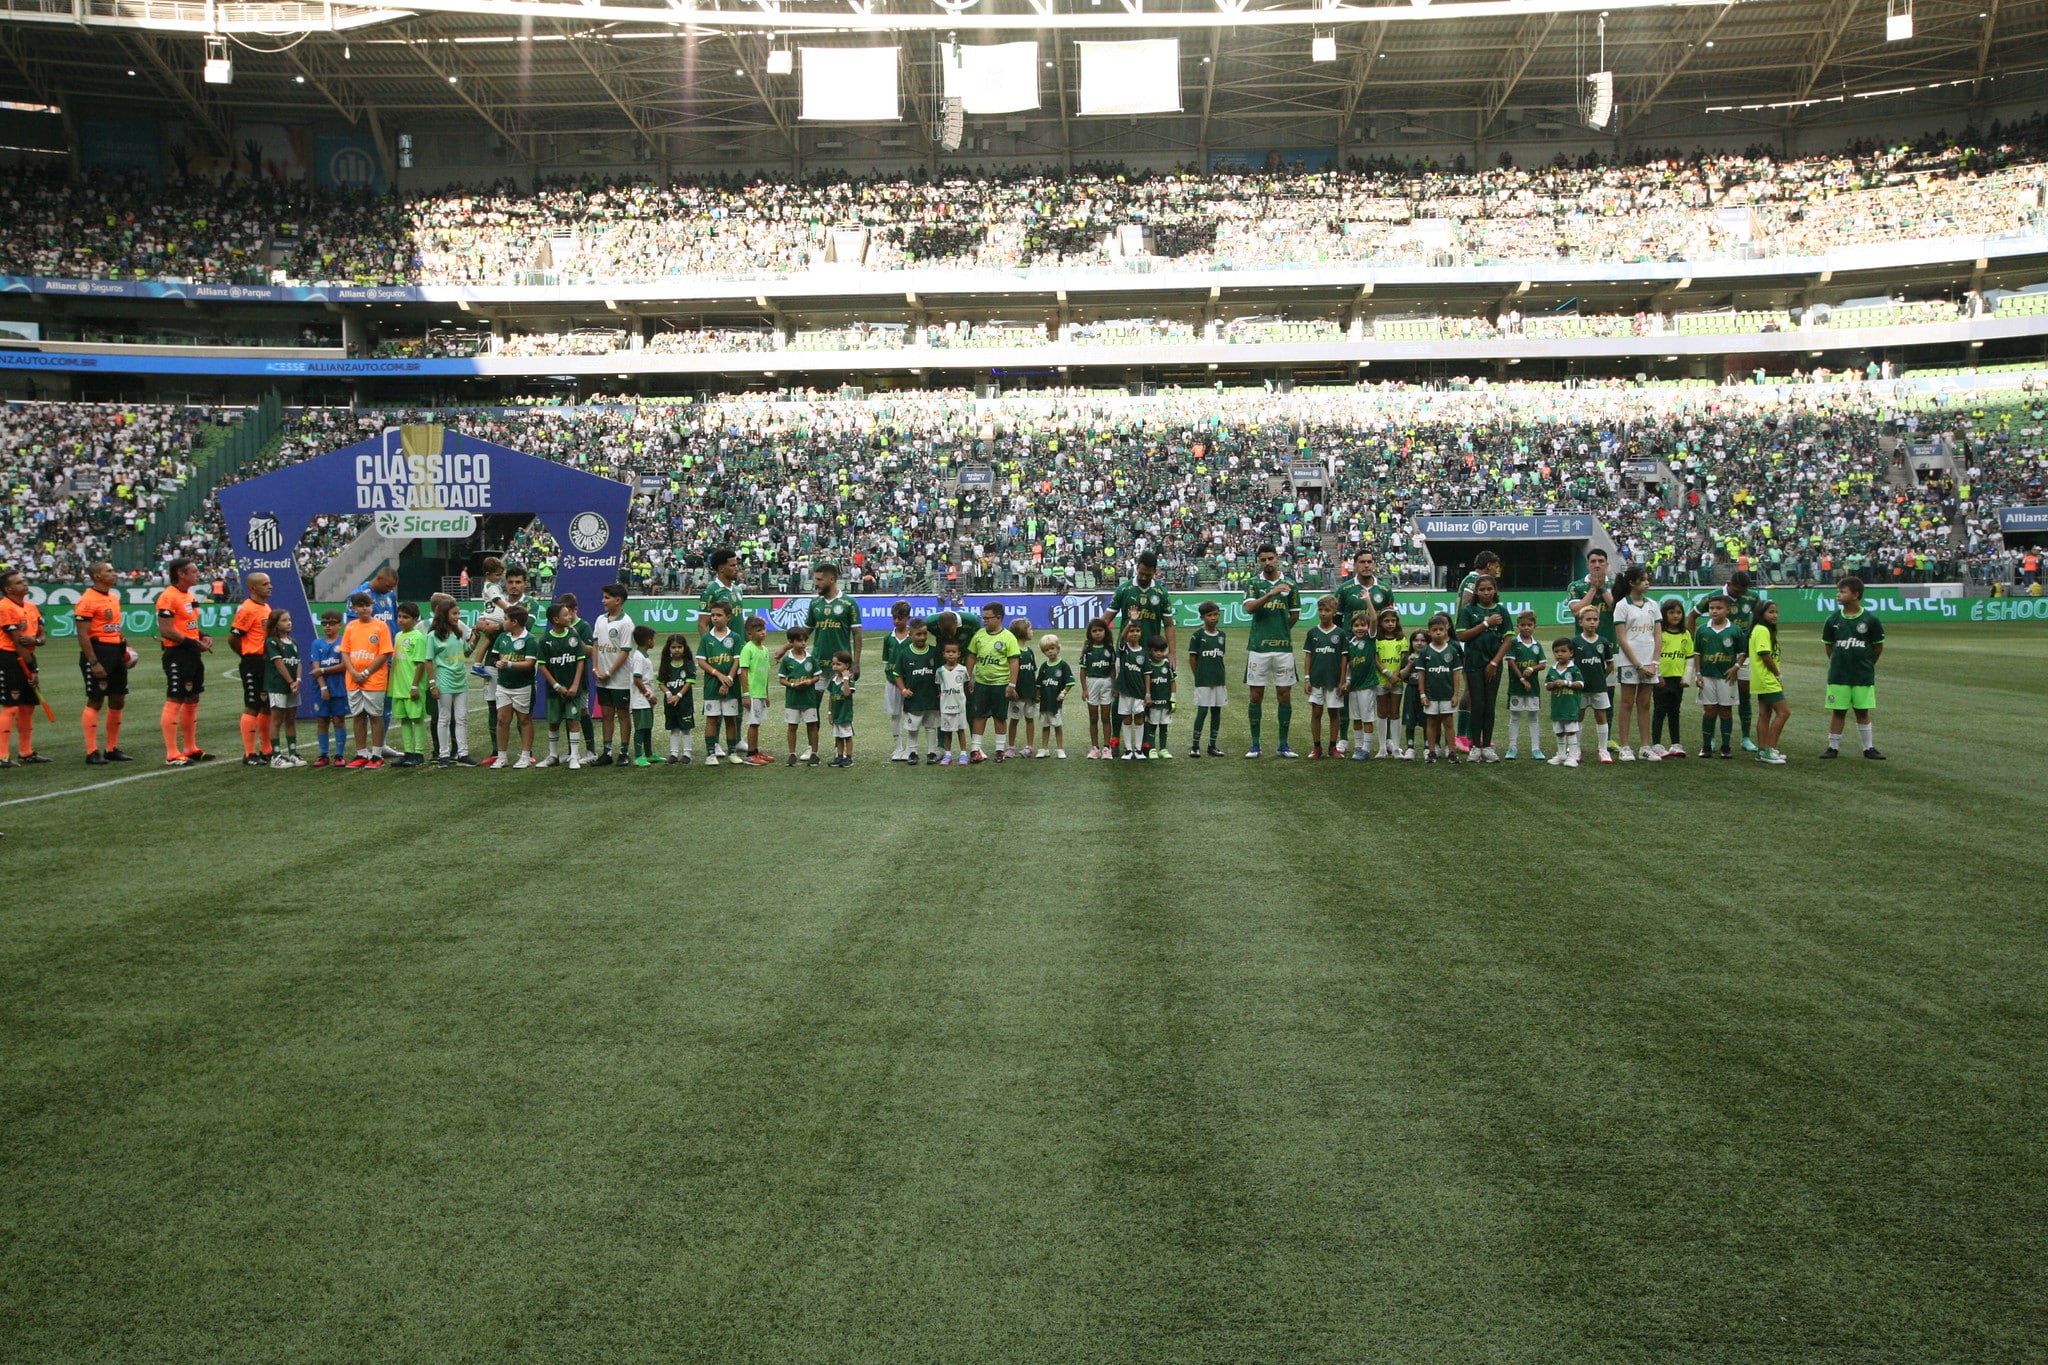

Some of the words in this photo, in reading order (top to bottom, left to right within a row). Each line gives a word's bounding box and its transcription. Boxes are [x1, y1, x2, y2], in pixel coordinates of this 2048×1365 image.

[45, 281, 77, 291] Allianz
[91, 283, 124, 293] Seguros
[196, 287, 229, 296] Allianz
[242, 288, 271, 298] Parque
[338, 289, 366, 299] Allianz
[377, 290, 406, 299] Seguros
[266, 361, 305, 372] ACESSE
[356, 448, 491, 484] CLÁSSICO
[356, 485, 386, 508] DA
[391, 484, 491, 509] SAUDADE
[403, 515, 469, 532] Sicredi
[1426, 520, 1469, 532] Allianz
[1489, 520, 1529, 536] Parque
[253, 558, 291, 569] Sicredi
[578, 555, 617, 567] Sicredi
